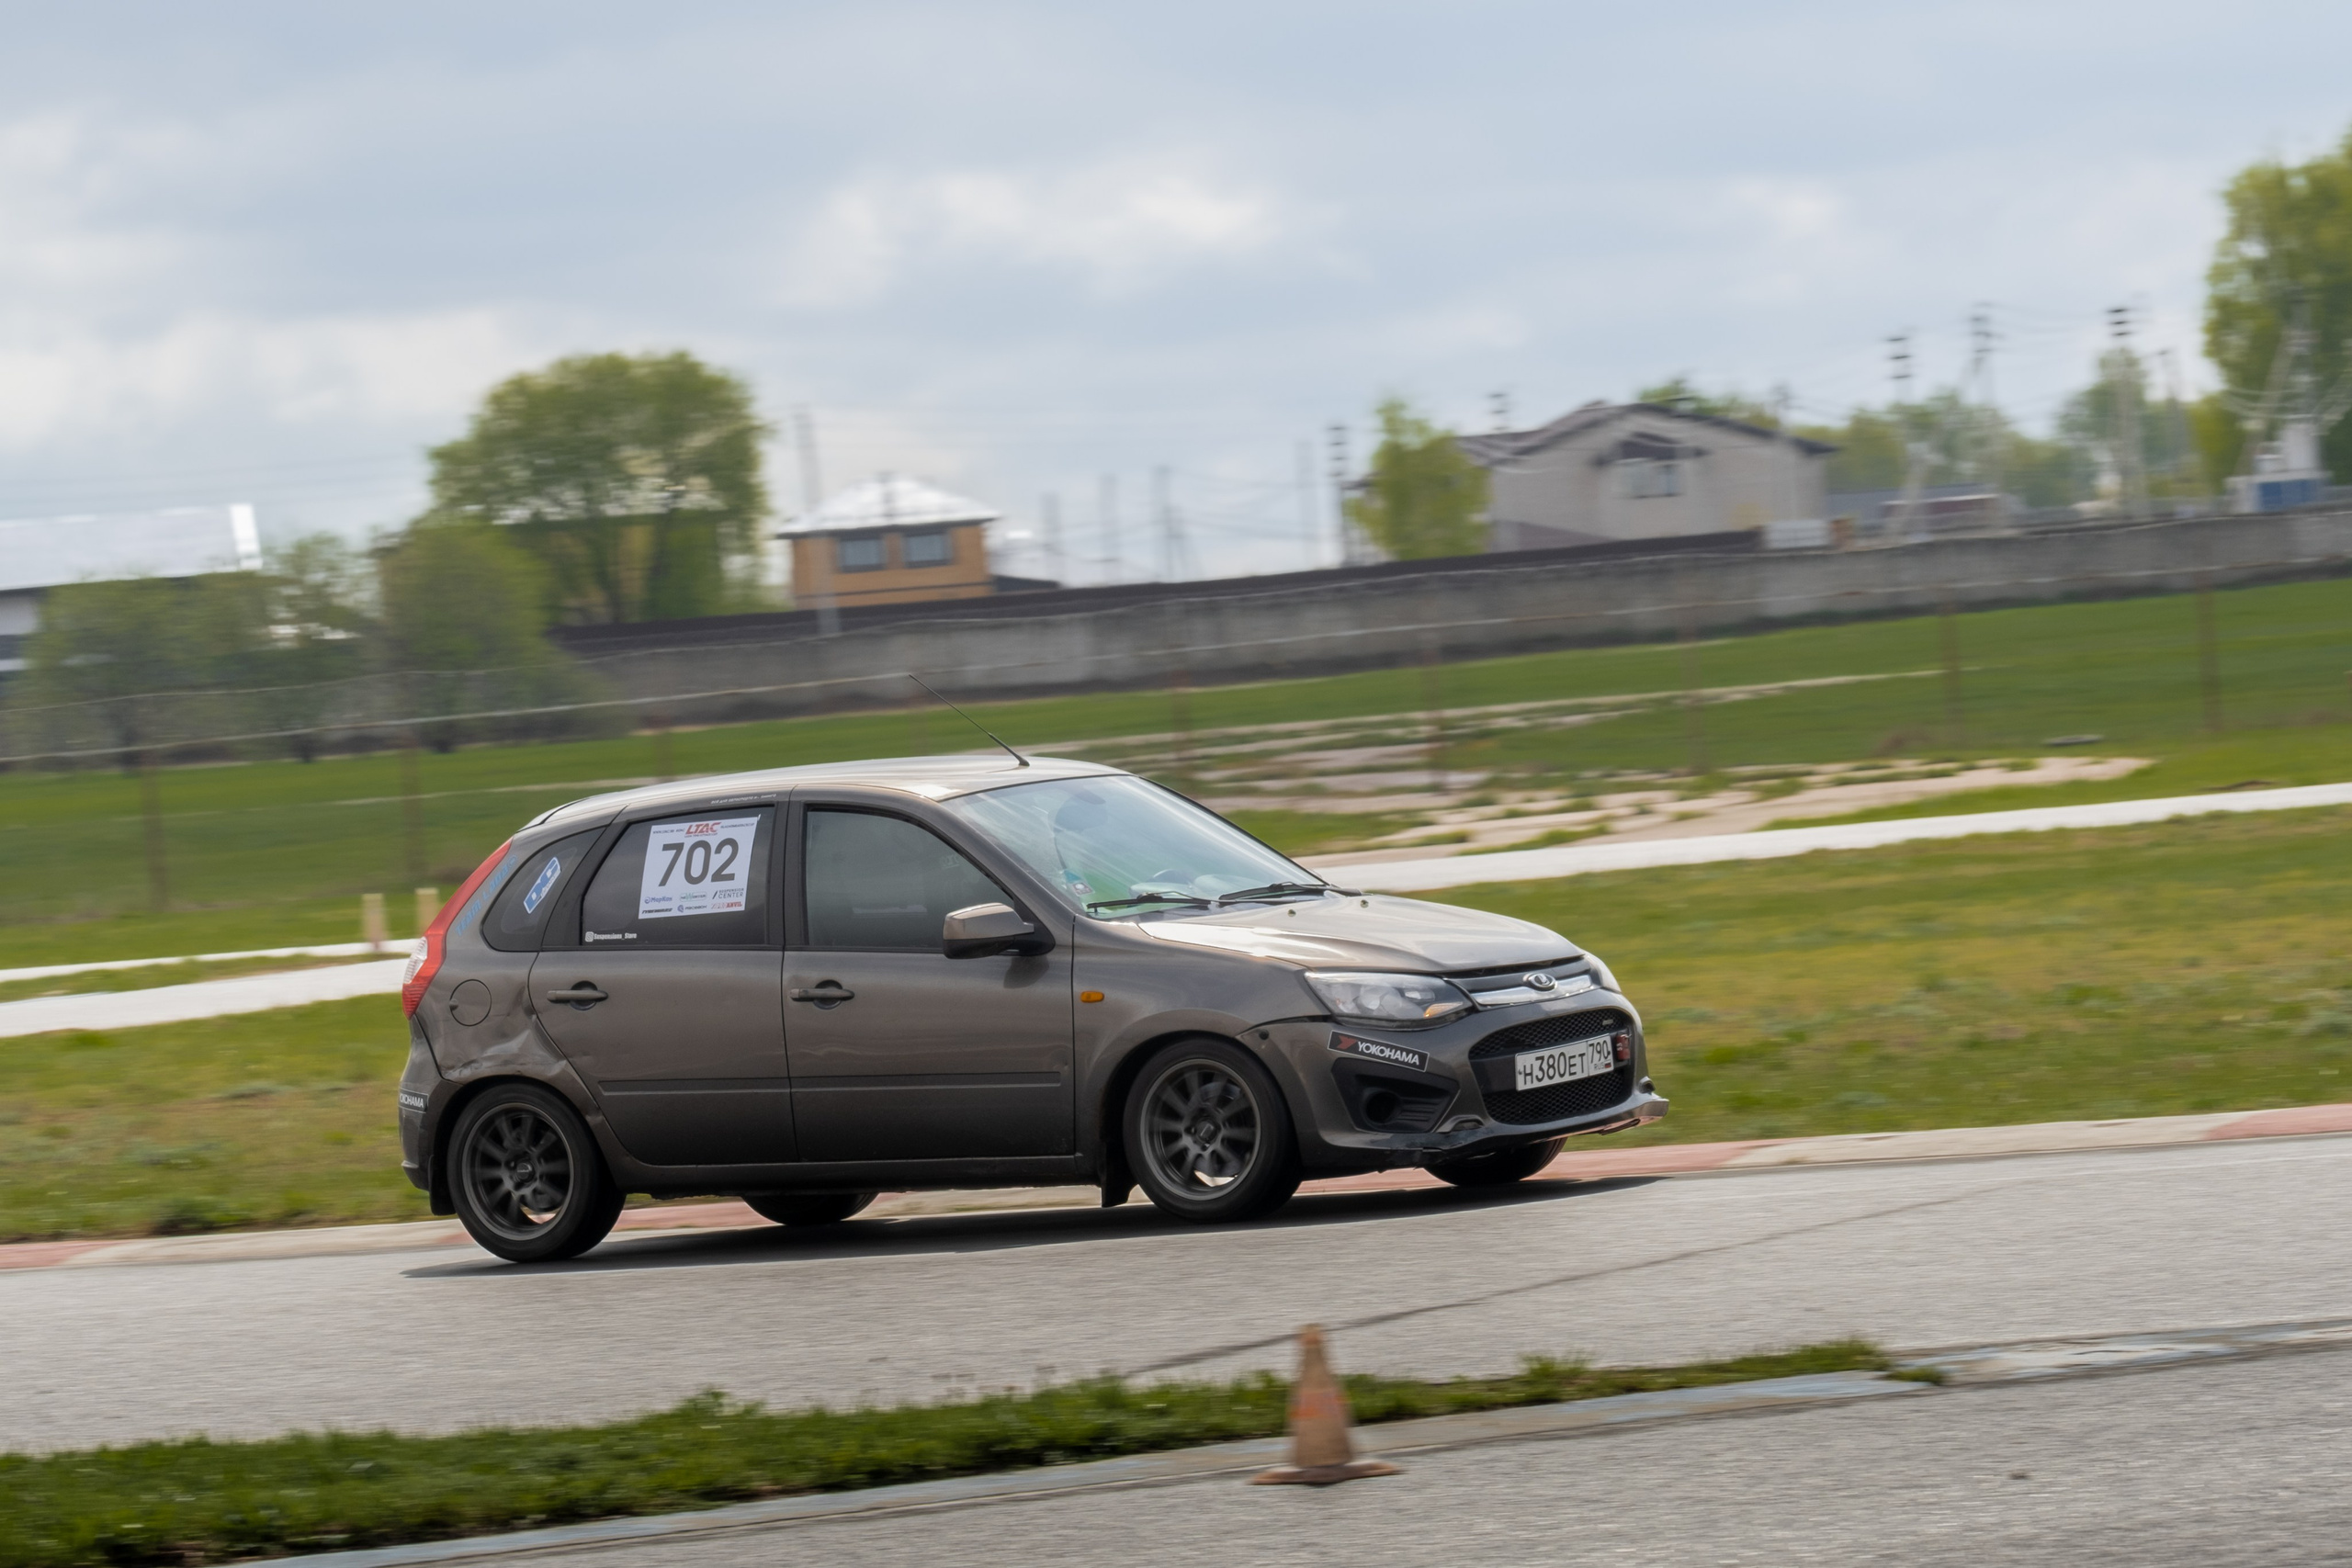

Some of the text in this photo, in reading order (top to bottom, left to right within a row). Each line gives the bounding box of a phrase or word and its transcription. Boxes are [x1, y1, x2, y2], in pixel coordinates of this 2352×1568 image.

[685, 821, 721, 834] LTAC
[659, 838, 740, 887] 702
[1357, 1041, 1419, 1066] YOKOHAMA
[1589, 1040, 1609, 1064] 790
[1593, 1062, 1605, 1070] RUS
